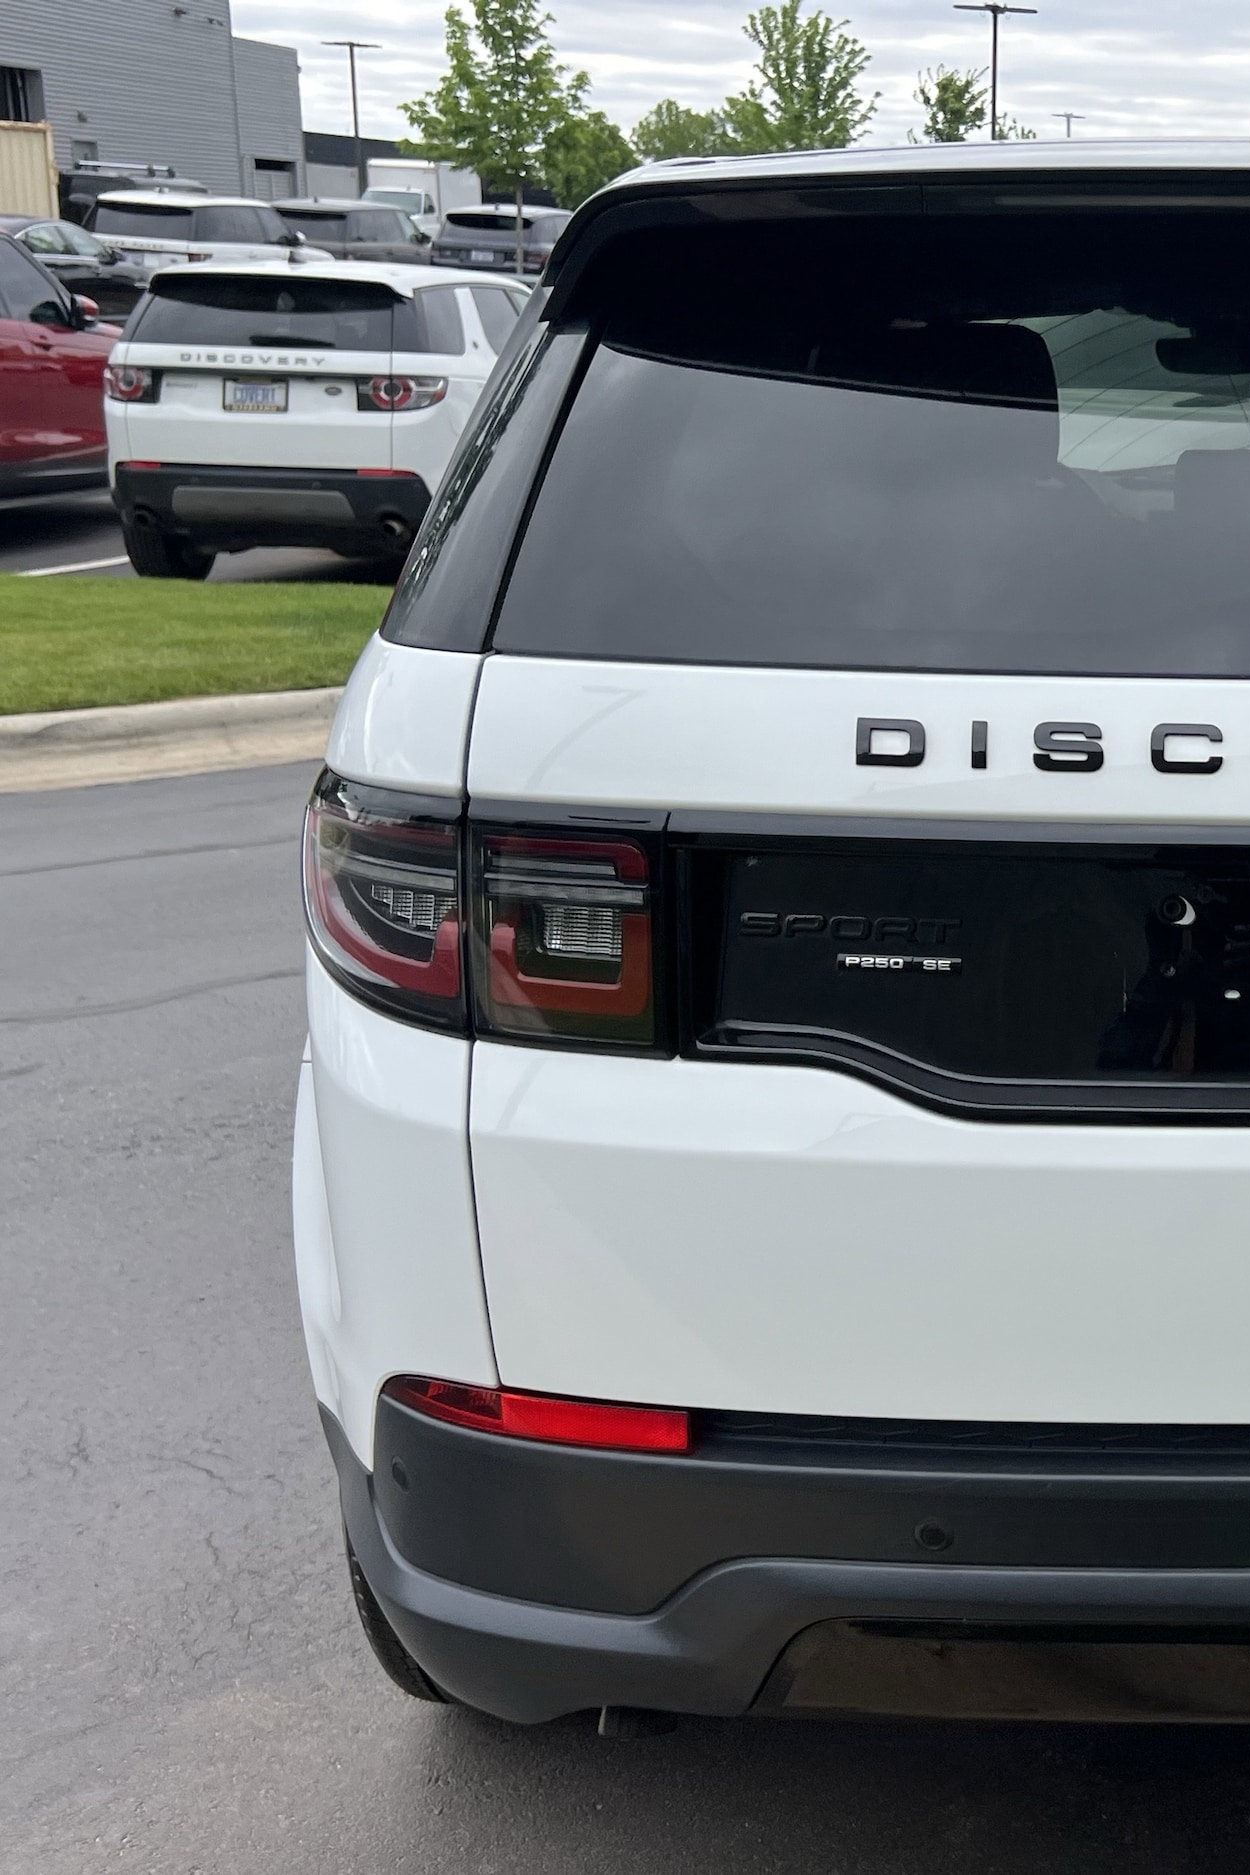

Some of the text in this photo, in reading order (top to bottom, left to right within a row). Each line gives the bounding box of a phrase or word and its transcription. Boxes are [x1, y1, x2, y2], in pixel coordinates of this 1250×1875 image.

[180, 353, 325, 366] DISCOVERY
[740, 911, 962, 944] SPORT
[844, 956, 952, 972] P250 SE
